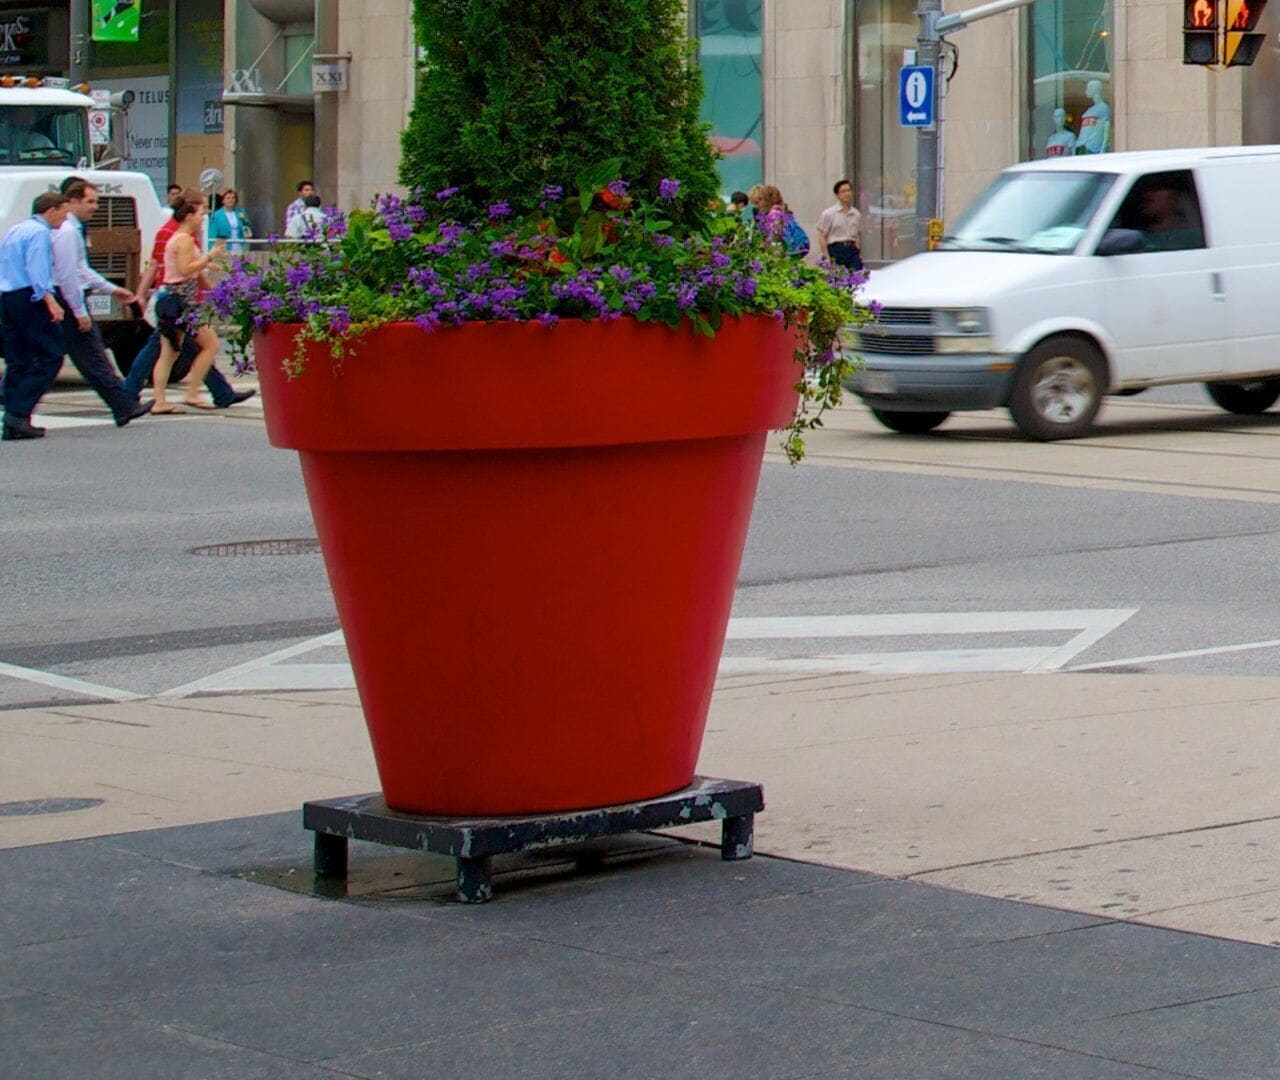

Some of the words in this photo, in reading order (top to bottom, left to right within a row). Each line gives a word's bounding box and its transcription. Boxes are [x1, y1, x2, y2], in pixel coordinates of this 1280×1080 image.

[230, 69, 262, 93] XXI
[315, 72, 342, 84] XXI
[139, 91, 169, 104] TELUS
[131, 136, 154, 150] Never
